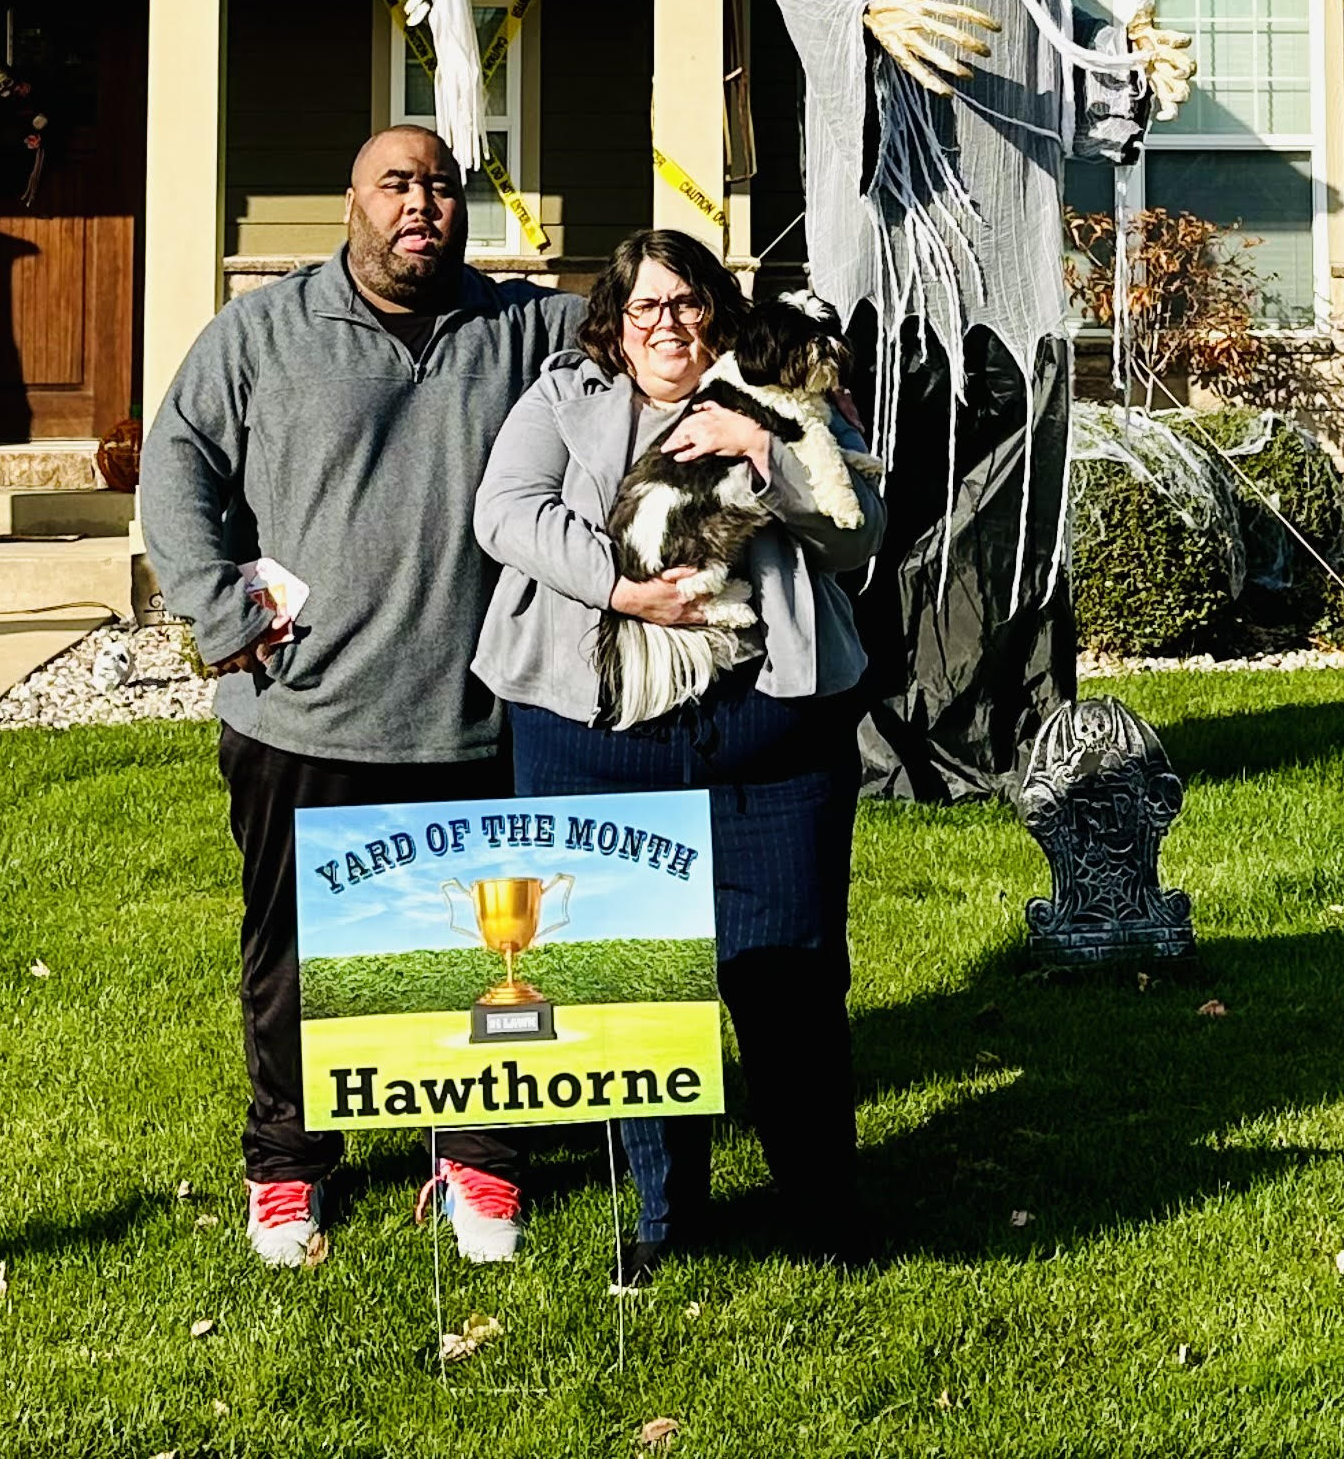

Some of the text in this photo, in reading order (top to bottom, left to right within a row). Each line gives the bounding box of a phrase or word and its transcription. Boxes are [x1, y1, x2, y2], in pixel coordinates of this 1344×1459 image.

[490, 165, 504, 180] DO
[509, 198, 531, 226] ENTER
[679, 181, 716, 215] CAUTION
[315, 813, 699, 895] YARD OF THE MONTH
[329, 1060, 702, 1119] Hawthorne
